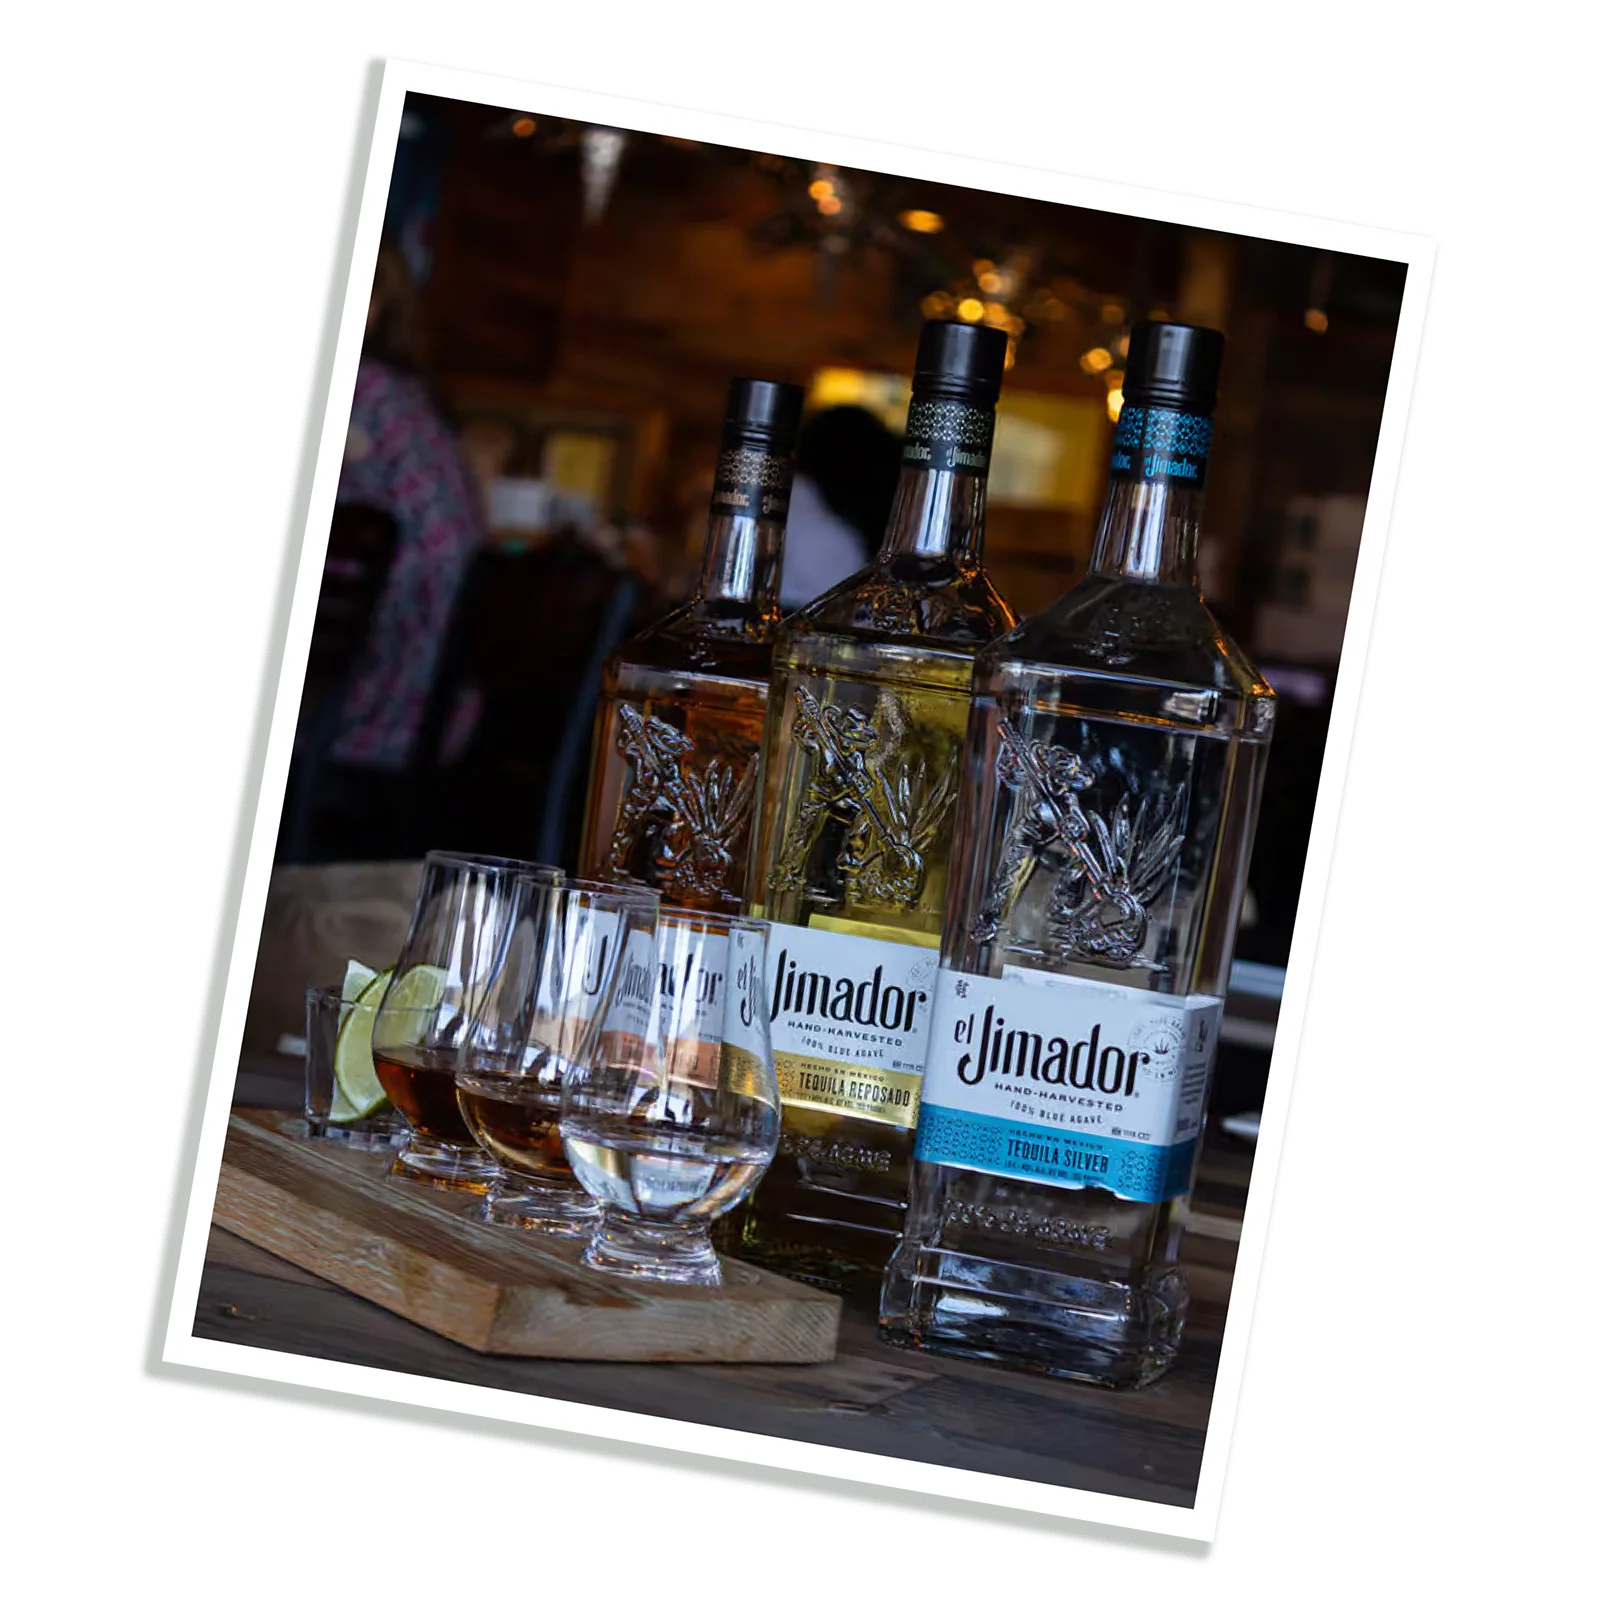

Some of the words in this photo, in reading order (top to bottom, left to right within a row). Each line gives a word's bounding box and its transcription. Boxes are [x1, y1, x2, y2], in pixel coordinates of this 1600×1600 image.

[770, 948, 928, 1033] Jimador
[786, 1021, 903, 1047] HAND-HARVESTED
[954, 1013, 975, 1045] el
[801, 1036, 823, 1050] 100%
[828, 1045, 850, 1056] BLUE
[855, 1048, 884, 1059] AGAVE
[957, 1004, 1151, 1098] Jimador
[801, 1062, 831, 1073] HECHO
[799, 1072, 845, 1096] TEQUILA
[849, 1081, 911, 1108] REPOSADO
[994, 1082, 1124, 1113] HAND-HARVESTED
[1010, 1100, 1035, 1116] 100%
[1039, 1109, 1065, 1123] BLUE
[1070, 1114, 1104, 1125] AGAVE
[1007, 1138, 1059, 1166] TEQUILA
[1064, 1149, 1109, 1174] SILVER
